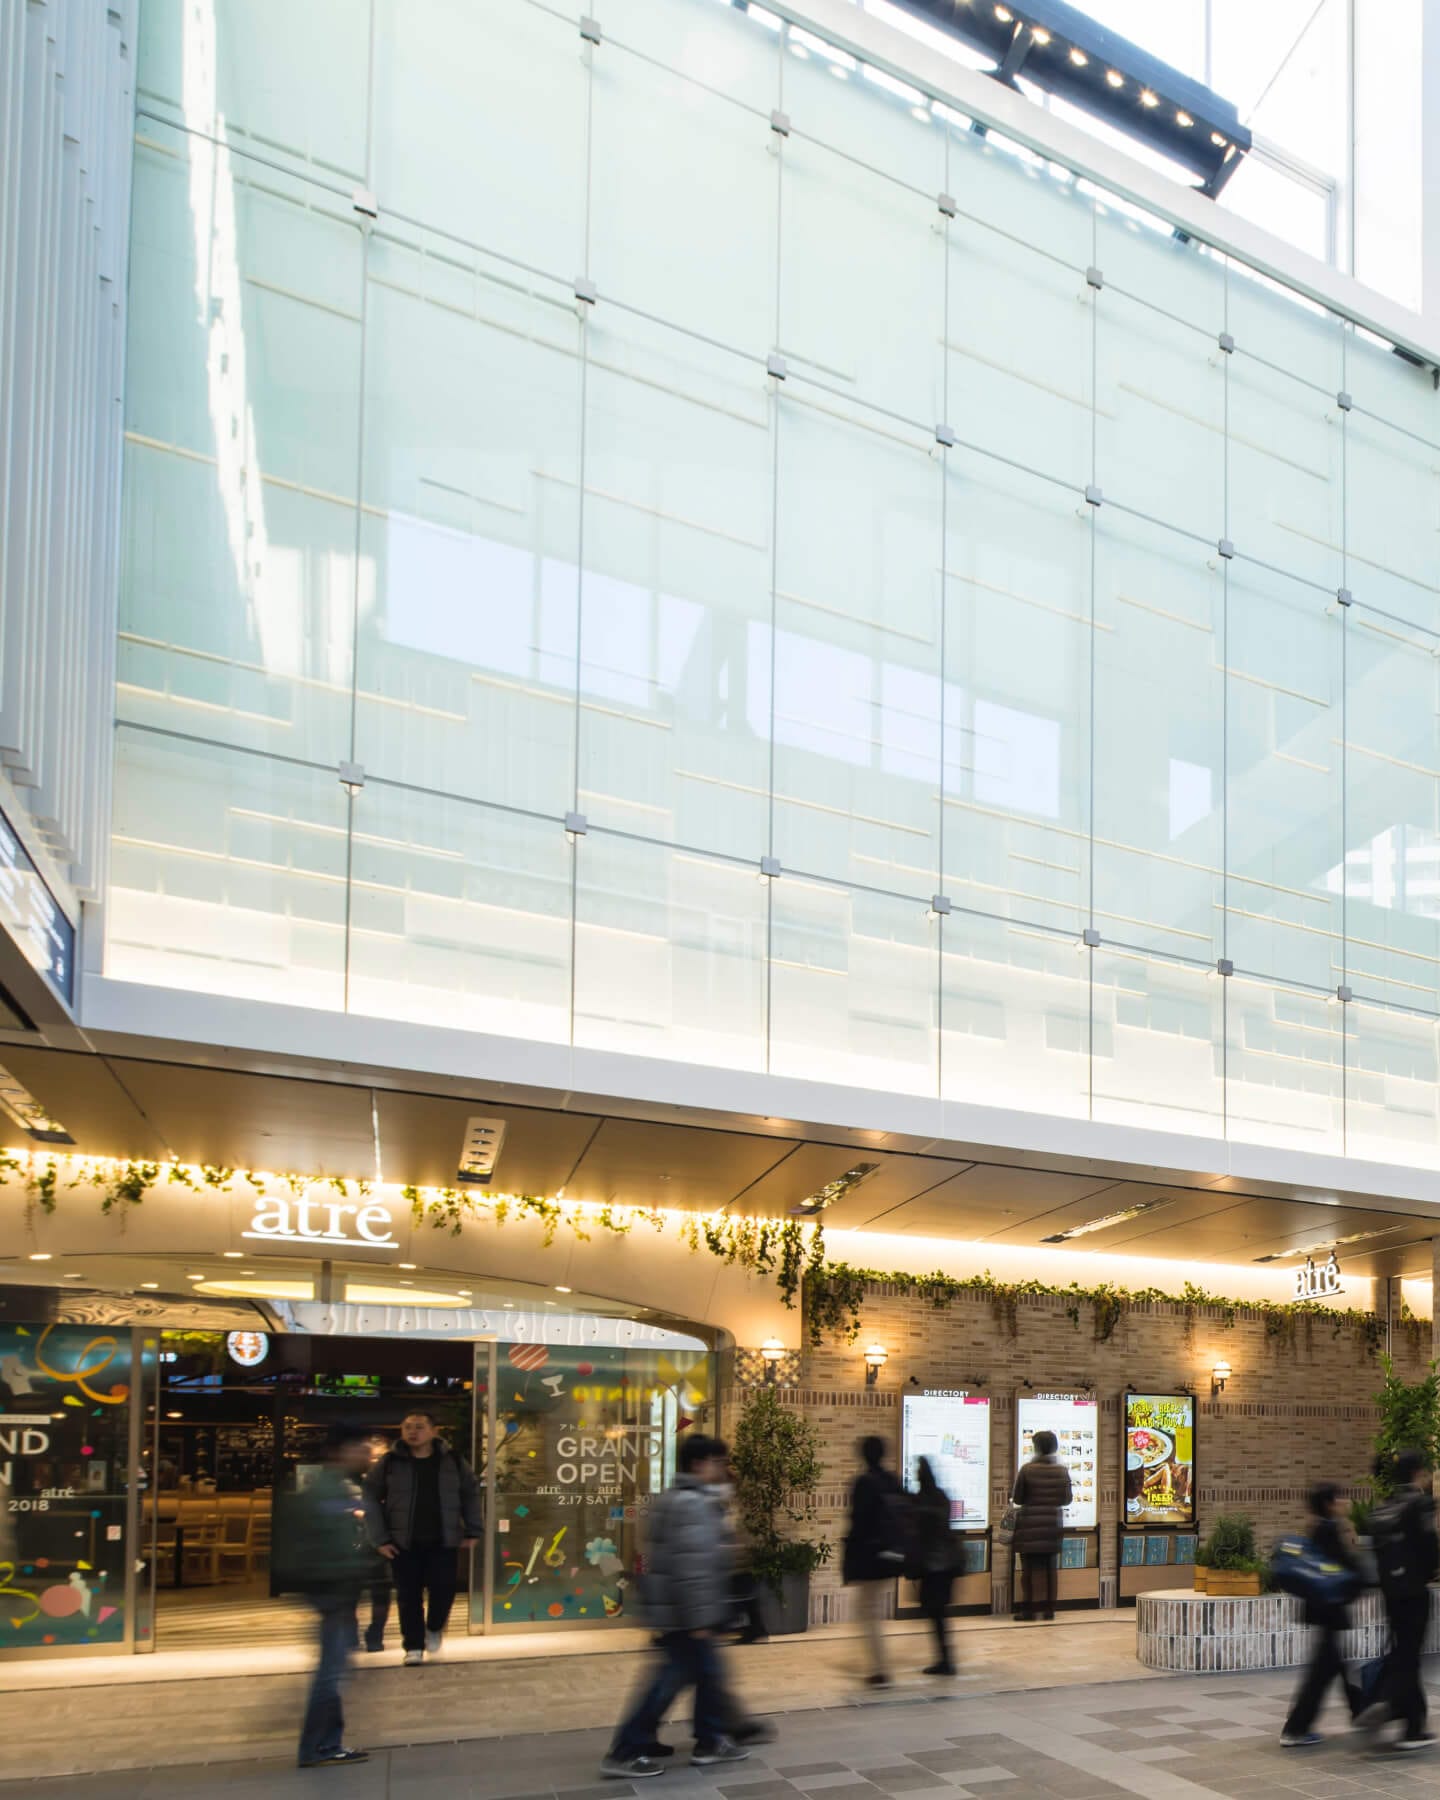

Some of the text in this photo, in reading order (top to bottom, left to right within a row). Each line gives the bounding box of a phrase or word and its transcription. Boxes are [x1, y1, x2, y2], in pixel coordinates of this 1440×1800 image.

[250, 1190, 393, 1242] atré
[1295, 1255, 1341, 1297] atré
[923, 1389, 969, 1398] DIRECTORY
[1037, 1392, 1079, 1401] DIRECTORY
[556, 1437, 662, 1458] GRAND
[556, 1463, 638, 1484] OPEN
[8, 1500, 49, 1511] 2018
[558, 1495, 582, 1505] 2.17
[585, 1495, 609, 1505] SAT
